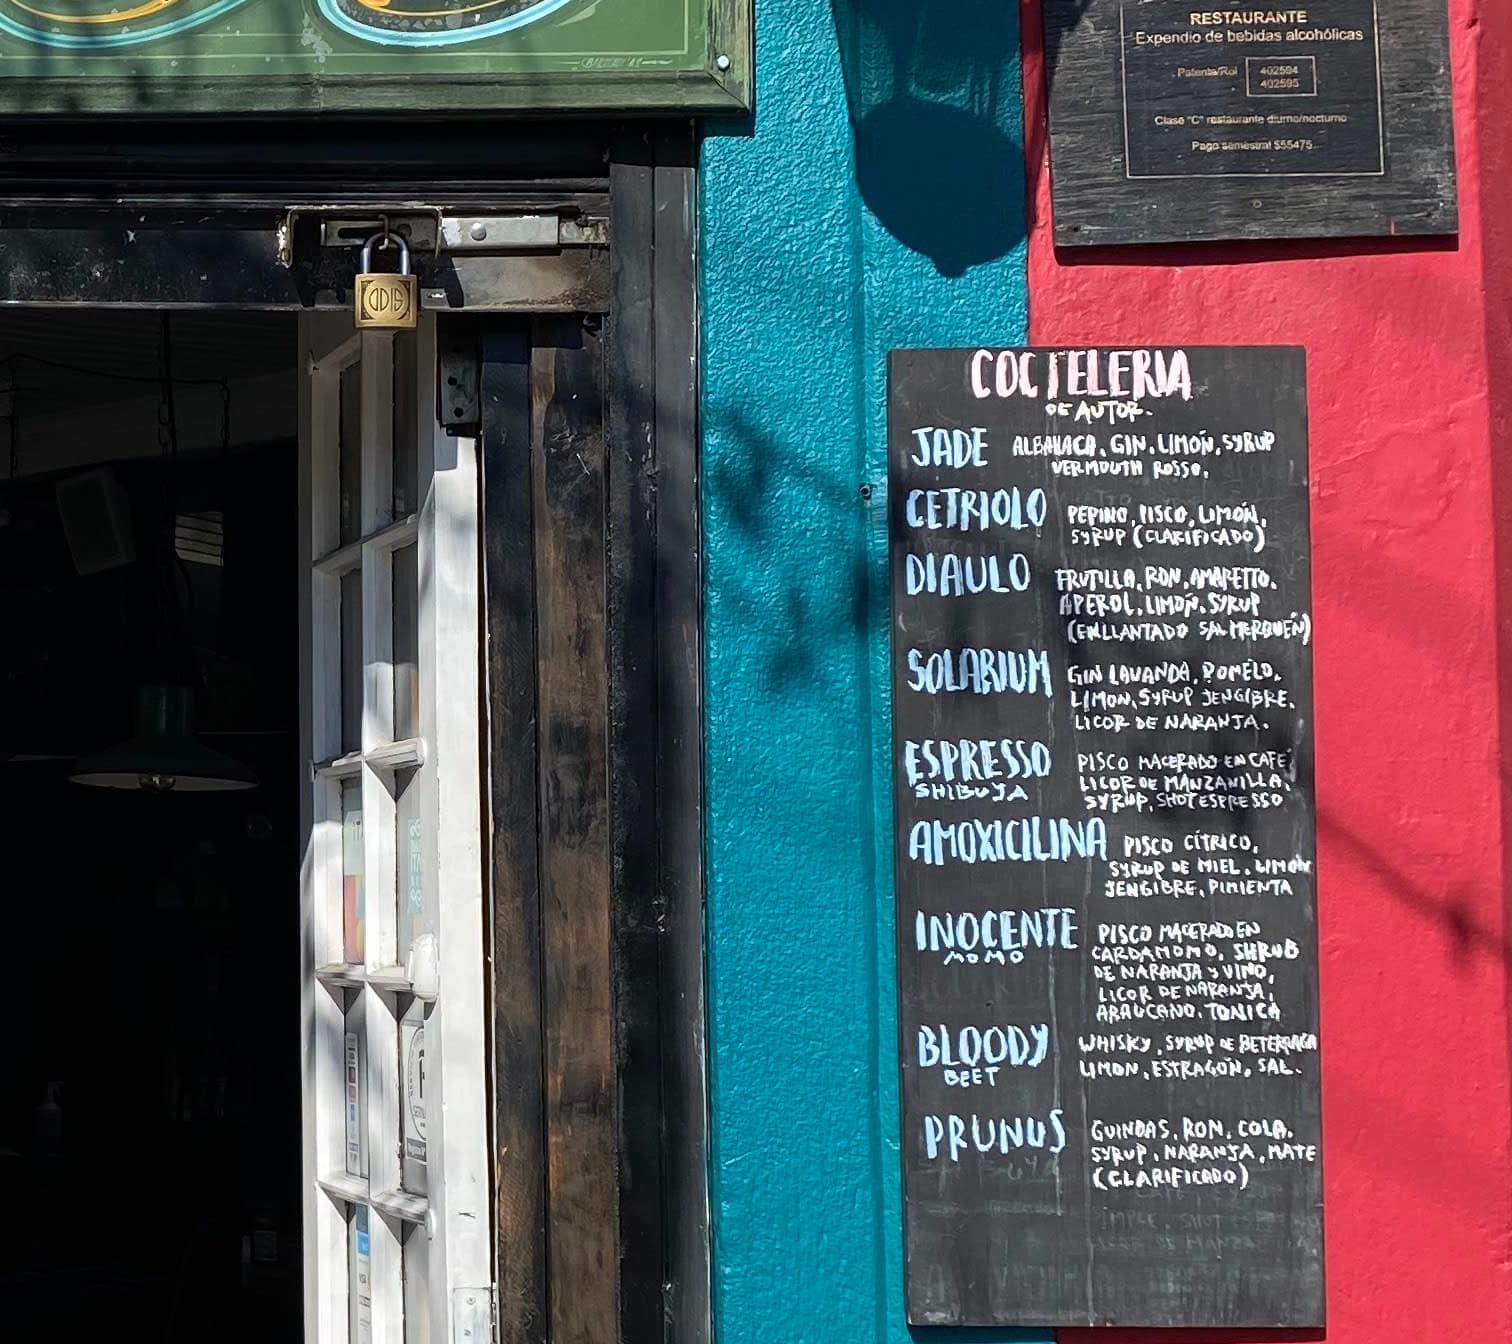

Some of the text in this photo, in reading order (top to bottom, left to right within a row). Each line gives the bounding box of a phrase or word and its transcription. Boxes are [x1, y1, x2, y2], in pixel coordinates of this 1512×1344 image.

[1190, 10, 1307, 26] RESTAURANTE
[1136, 28, 1364, 46] Expendio de bebidas alcohólicas
[971, 349, 1193, 400] COCTELERIA
[911, 427, 988, 468] JADE
[1052, 460, 1142, 476] VERMOUTH
[906, 487, 1047, 530] CETRIOLO
[906, 552, 1031, 597] DIAULO
[907, 647, 1053, 698] SOLARIUM
[1068, 665, 1103, 686] GIN
[1075, 714, 1130, 733] LICOR
[1136, 715, 1158, 730] DE
[905, 739, 1051, 786] ESPRESSO
[1078, 752, 1129, 772] PISCO
[1139, 752, 1217, 773] MACERADO
[1224, 754, 1246, 768] EN
[915, 782, 1028, 802] SHIBUYA
[1080, 775, 1136, 792] LICOR
[1139, 776, 1158, 790] DE
[908, 816, 1108, 865] AMOXICILINA
[1124, 836, 1173, 857] PISCO
[1171, 861, 1190, 875] DE
[1208, 879, 1294, 896] PIMIENTA
[915, 907, 1079, 953] INOCENTE
[1098, 924, 1152, 944] PISCO
[1237, 921, 1261, 939] EN
[943, 950, 1025, 965] MOMO
[1234, 939, 1300, 962] SHRUB
[1094, 965, 1116, 981] DE
[1120, 963, 1203, 981] NARANJA
[1099, 985, 1153, 1004] LICOR
[1159, 986, 1181, 999] DE
[918, 1023, 1048, 1067] BLOODY
[944, 1066, 1000, 1086] BEET
[924, 1109, 1066, 1162] PRUNUS
[1268, 1143, 1317, 1161] MATE
